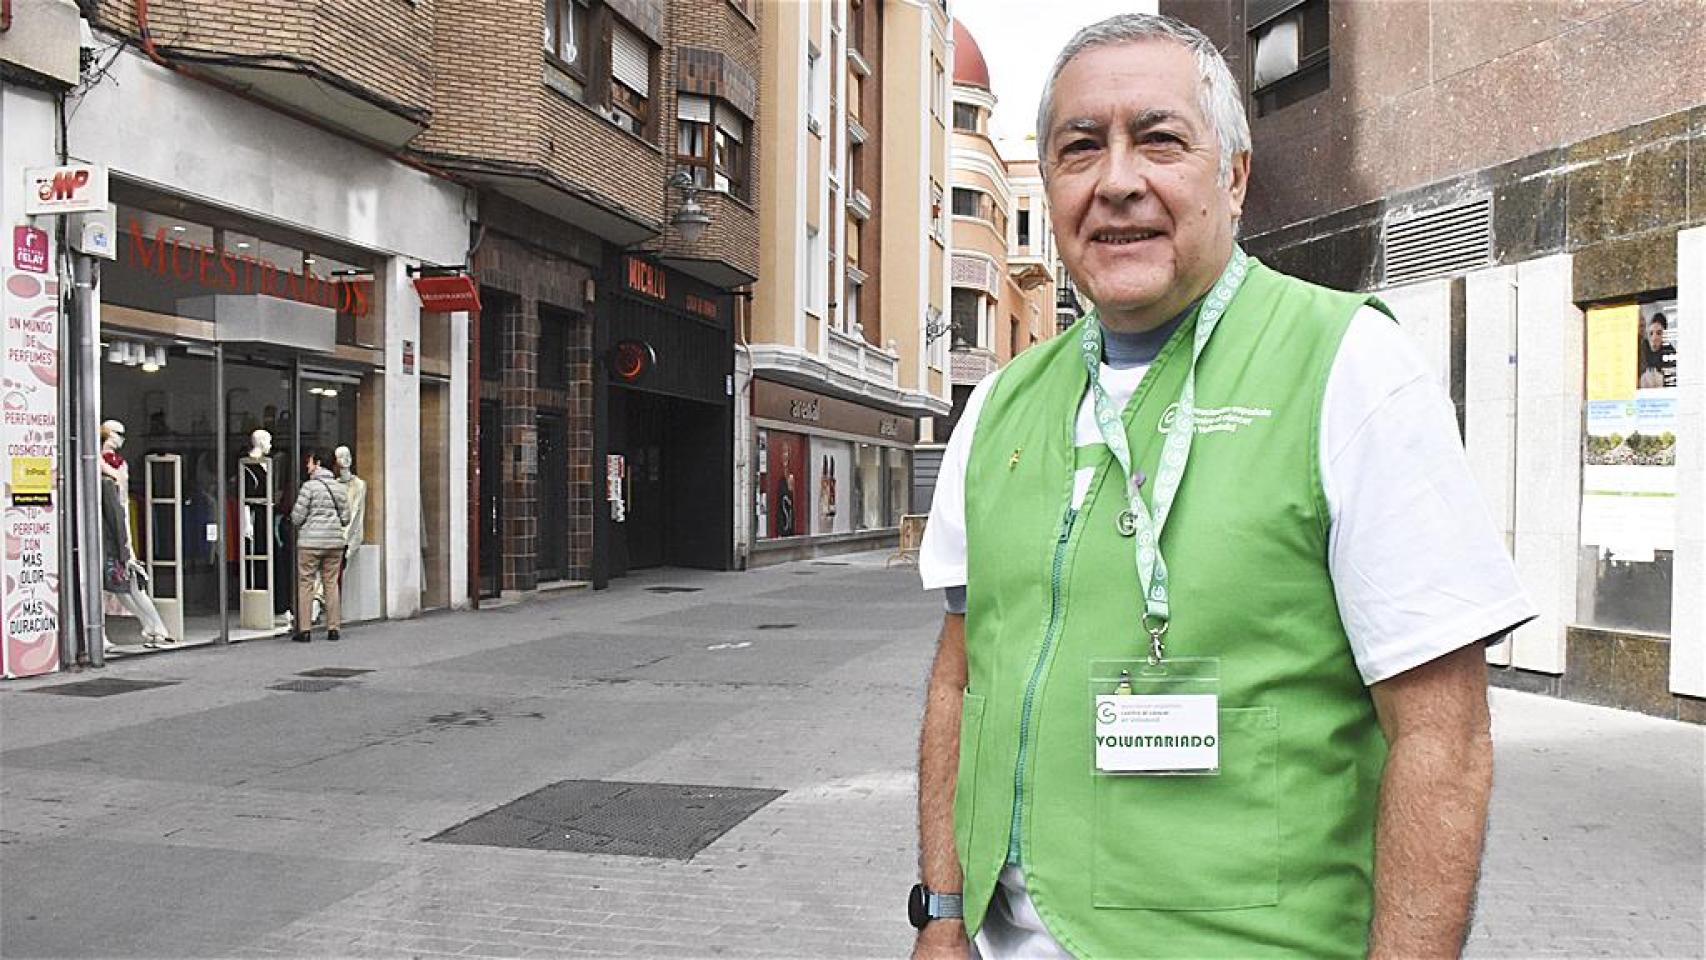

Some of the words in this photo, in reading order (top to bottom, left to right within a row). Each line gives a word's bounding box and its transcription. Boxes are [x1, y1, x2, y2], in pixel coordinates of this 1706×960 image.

[127, 213, 370, 319] MUESTRARIOS
[23, 319, 53, 334] MUNDO
[9, 348, 53, 365] PERFUMES
[13, 522, 51, 535] PERFUME
[20, 569, 44, 584] OLOR
[1096, 735, 1216, 747] VOLUNTARIADO
